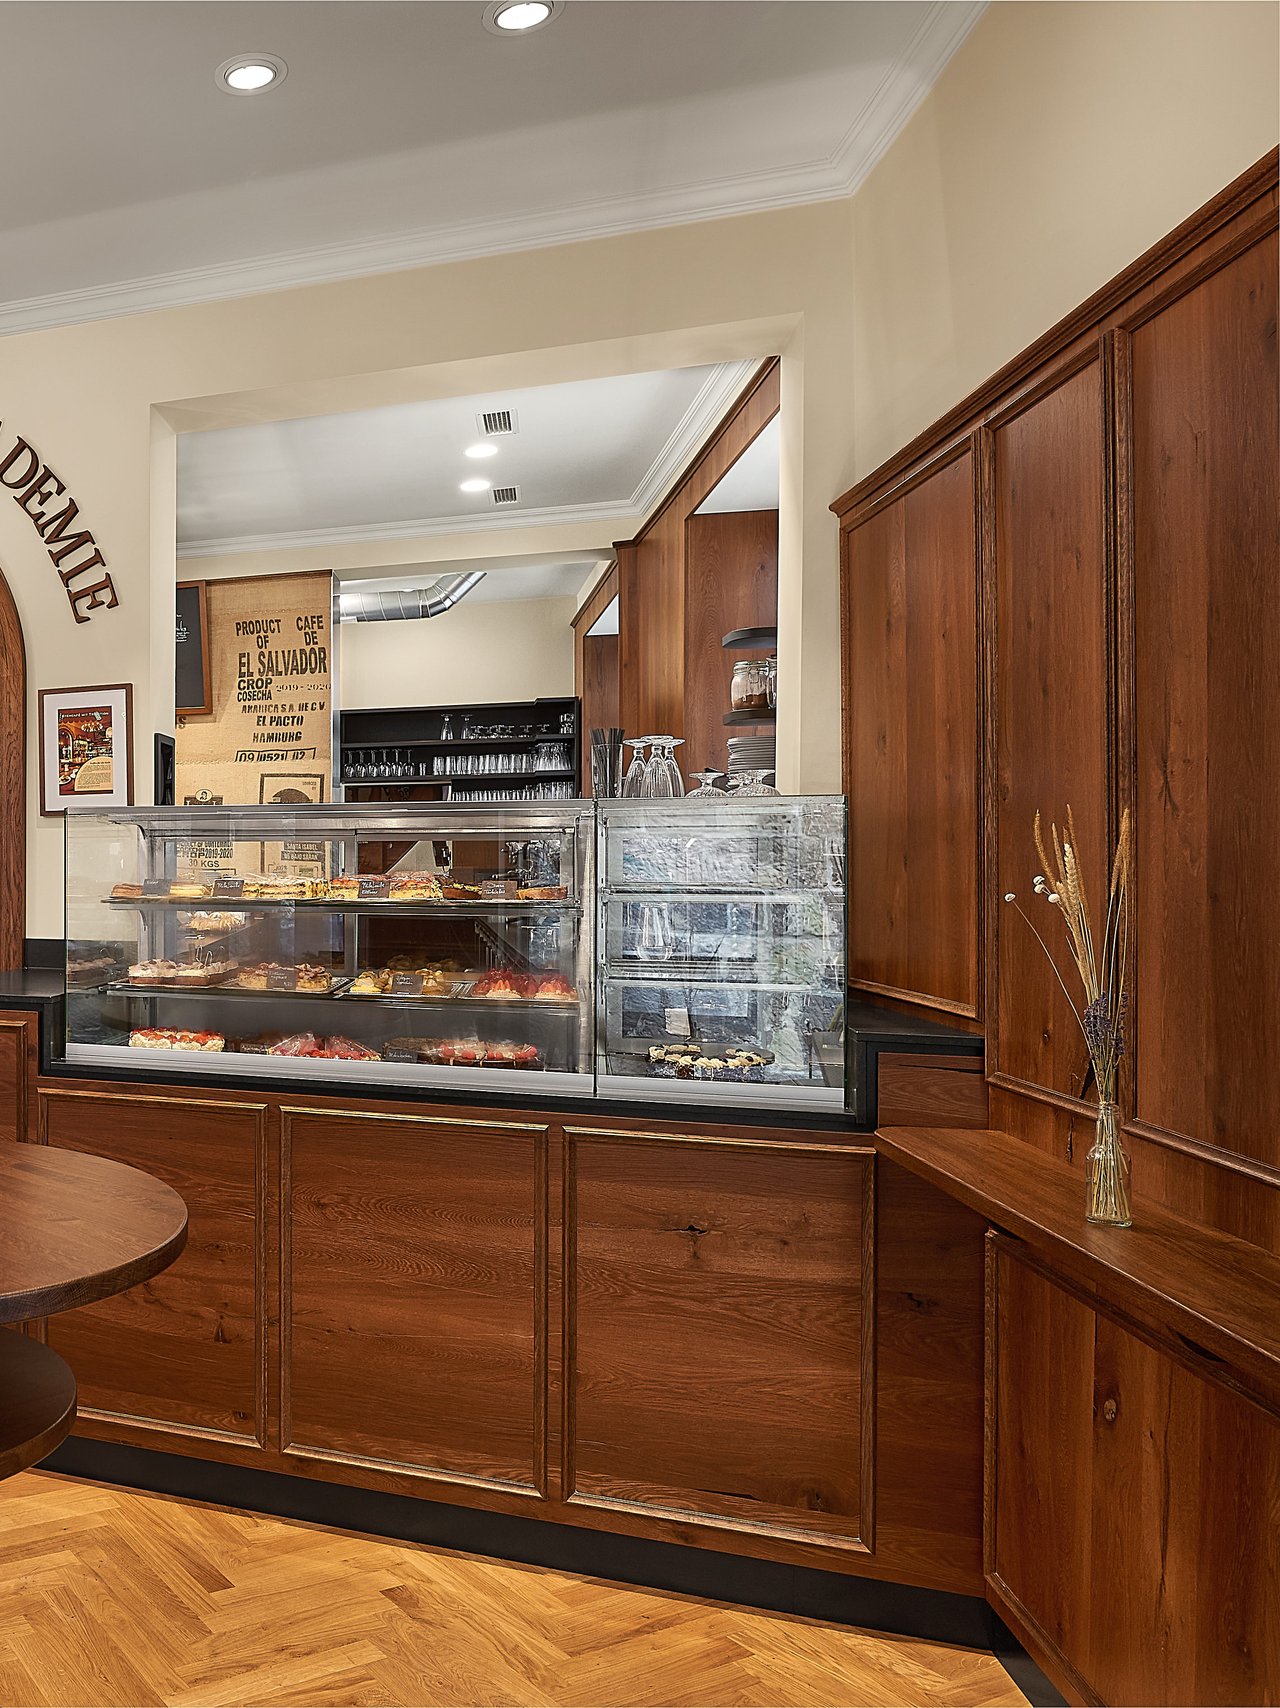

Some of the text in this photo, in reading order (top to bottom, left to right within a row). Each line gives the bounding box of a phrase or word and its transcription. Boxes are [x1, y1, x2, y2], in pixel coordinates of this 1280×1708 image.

[235, 614, 324, 636] PRODUCT CAFE
[256, 631, 319, 649] OF DE
[238, 646, 327, 678] EL SALVADOR
[237, 677, 273, 691] CROP
[237, 690, 273, 702] COSECHA
[256, 715, 305, 727] EL PACTO
[252, 731, 303, 743] HAMBURG
[200, 860, 220, 868] KGS
